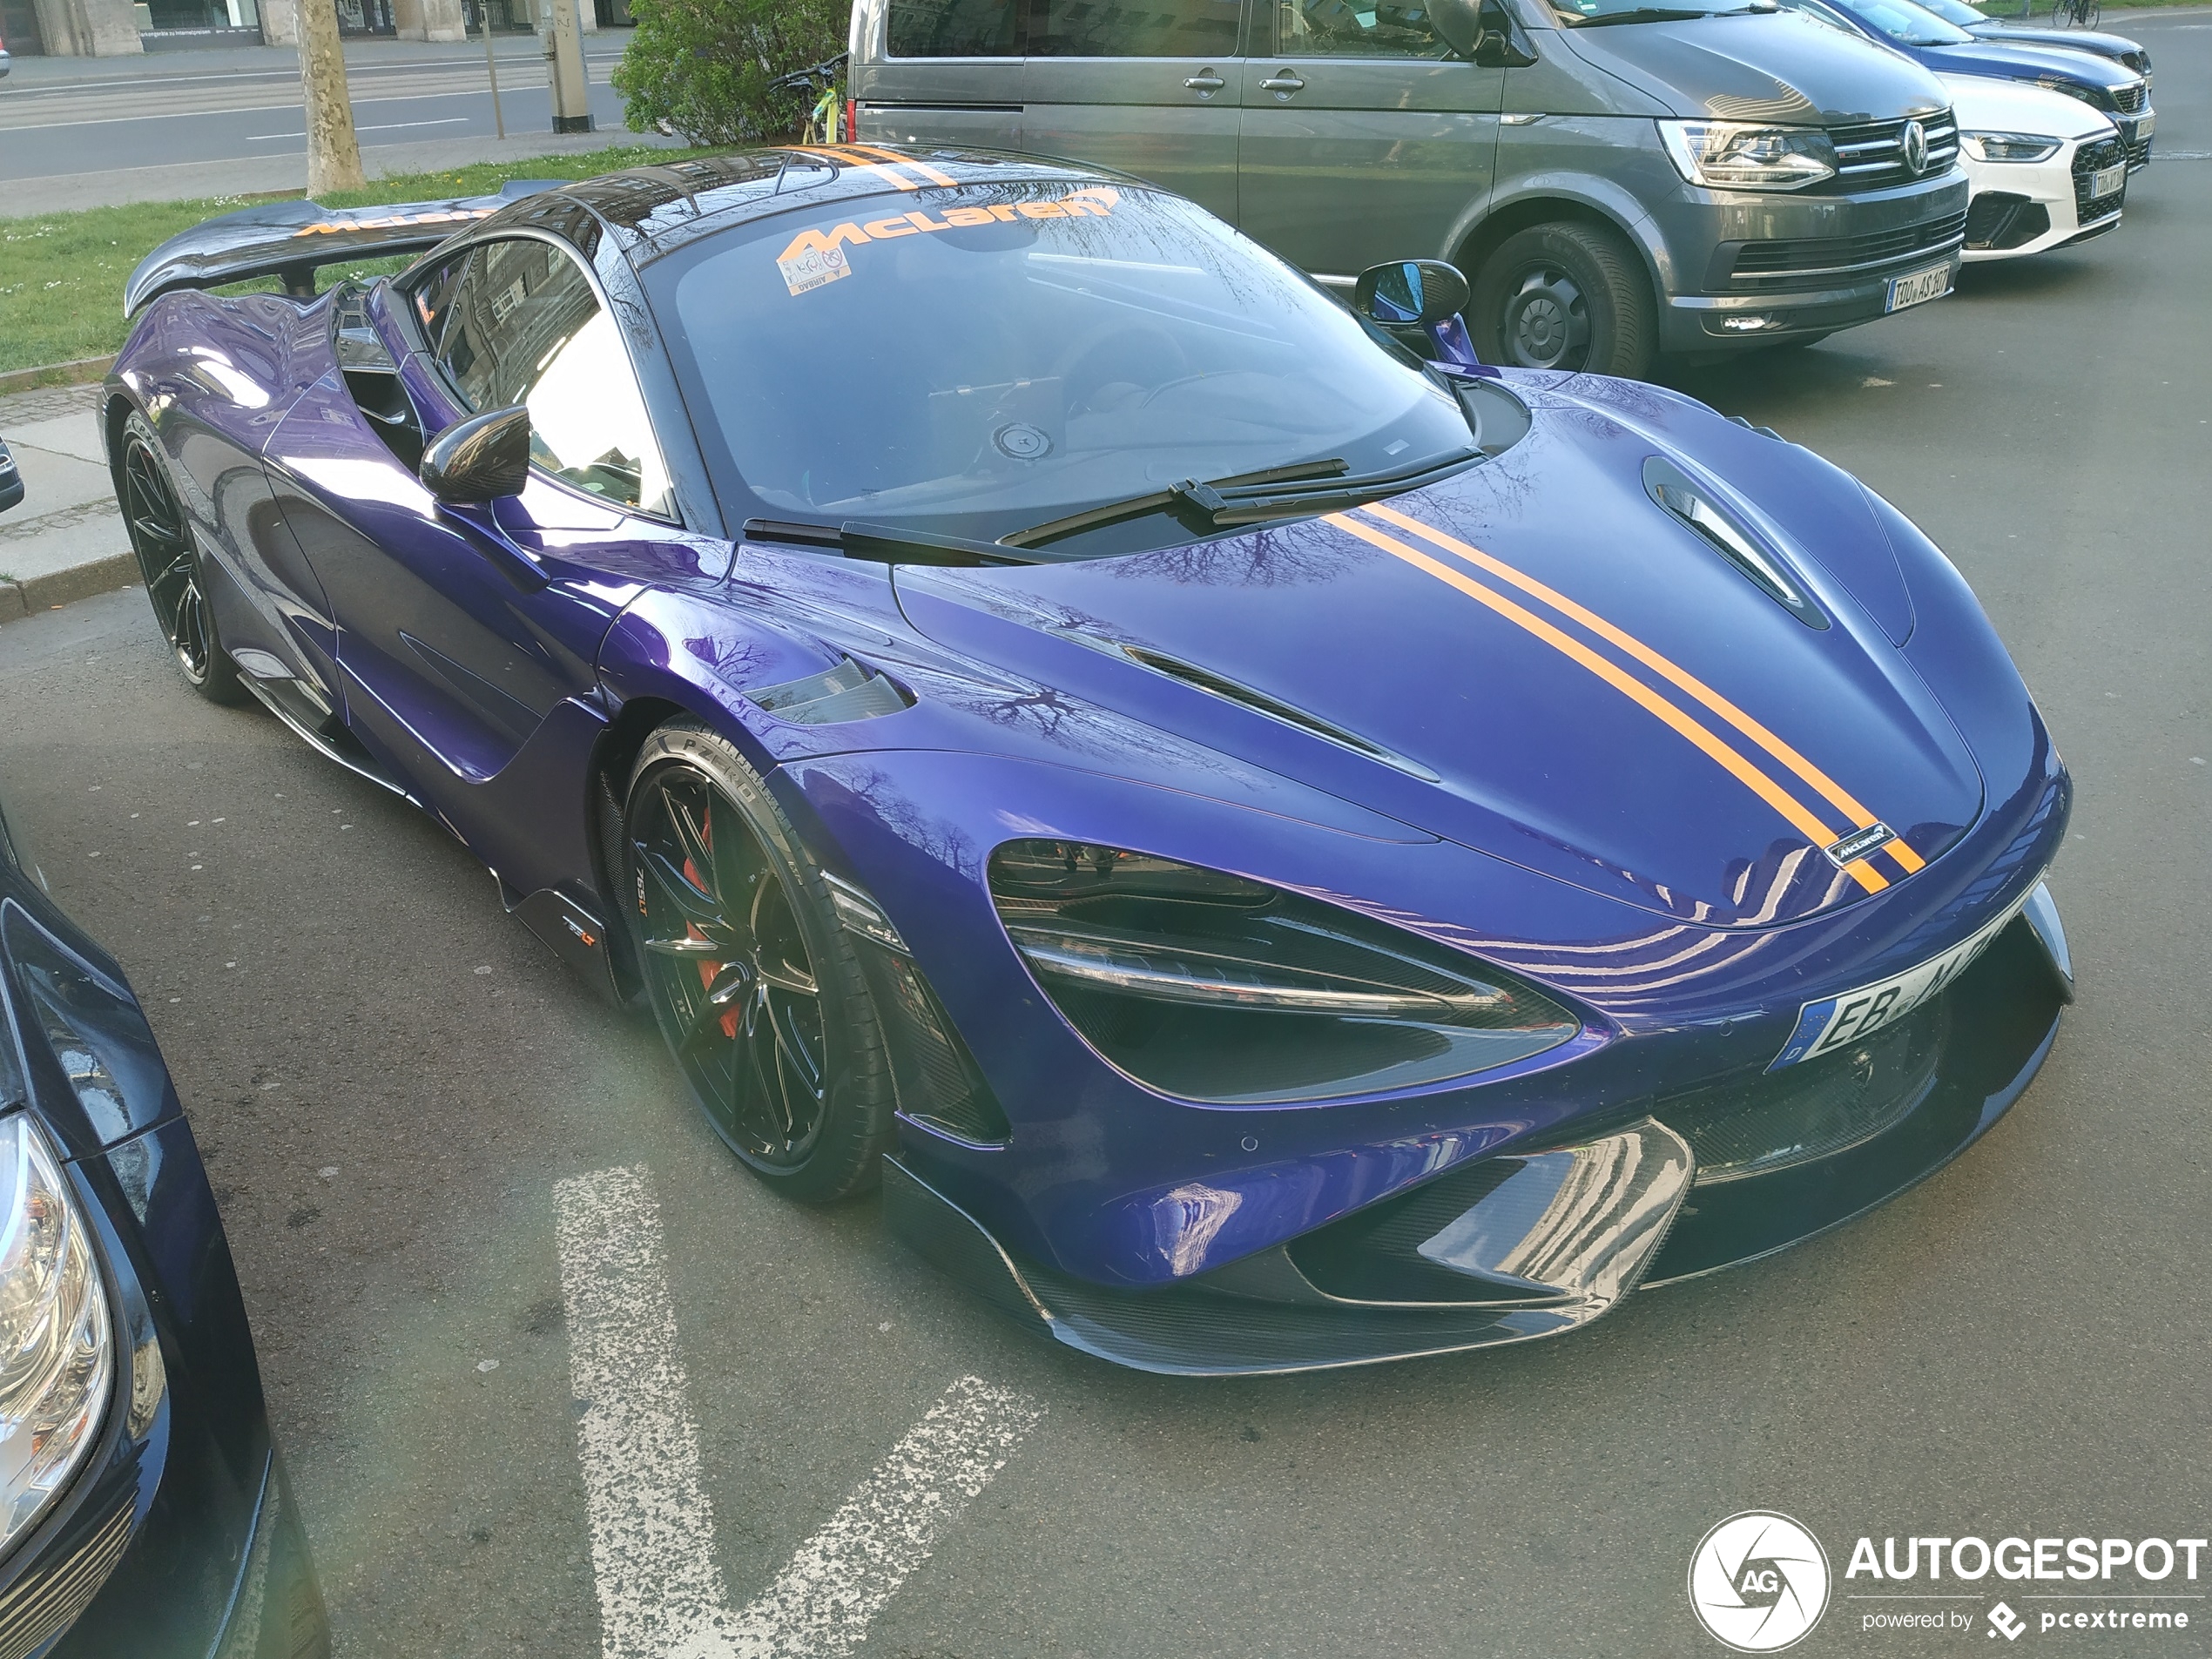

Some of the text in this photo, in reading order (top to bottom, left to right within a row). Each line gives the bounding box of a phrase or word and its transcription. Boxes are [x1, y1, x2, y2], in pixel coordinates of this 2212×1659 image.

[777, 199, 1112, 263] McLaren
[798, 275, 826, 292] AIRBAG
[1895, 280, 1914, 307] TDO
[1839, 827, 1885, 859] McLaren
[636, 867, 648, 918] 765LT
[1815, 986, 1901, 1052] EB
